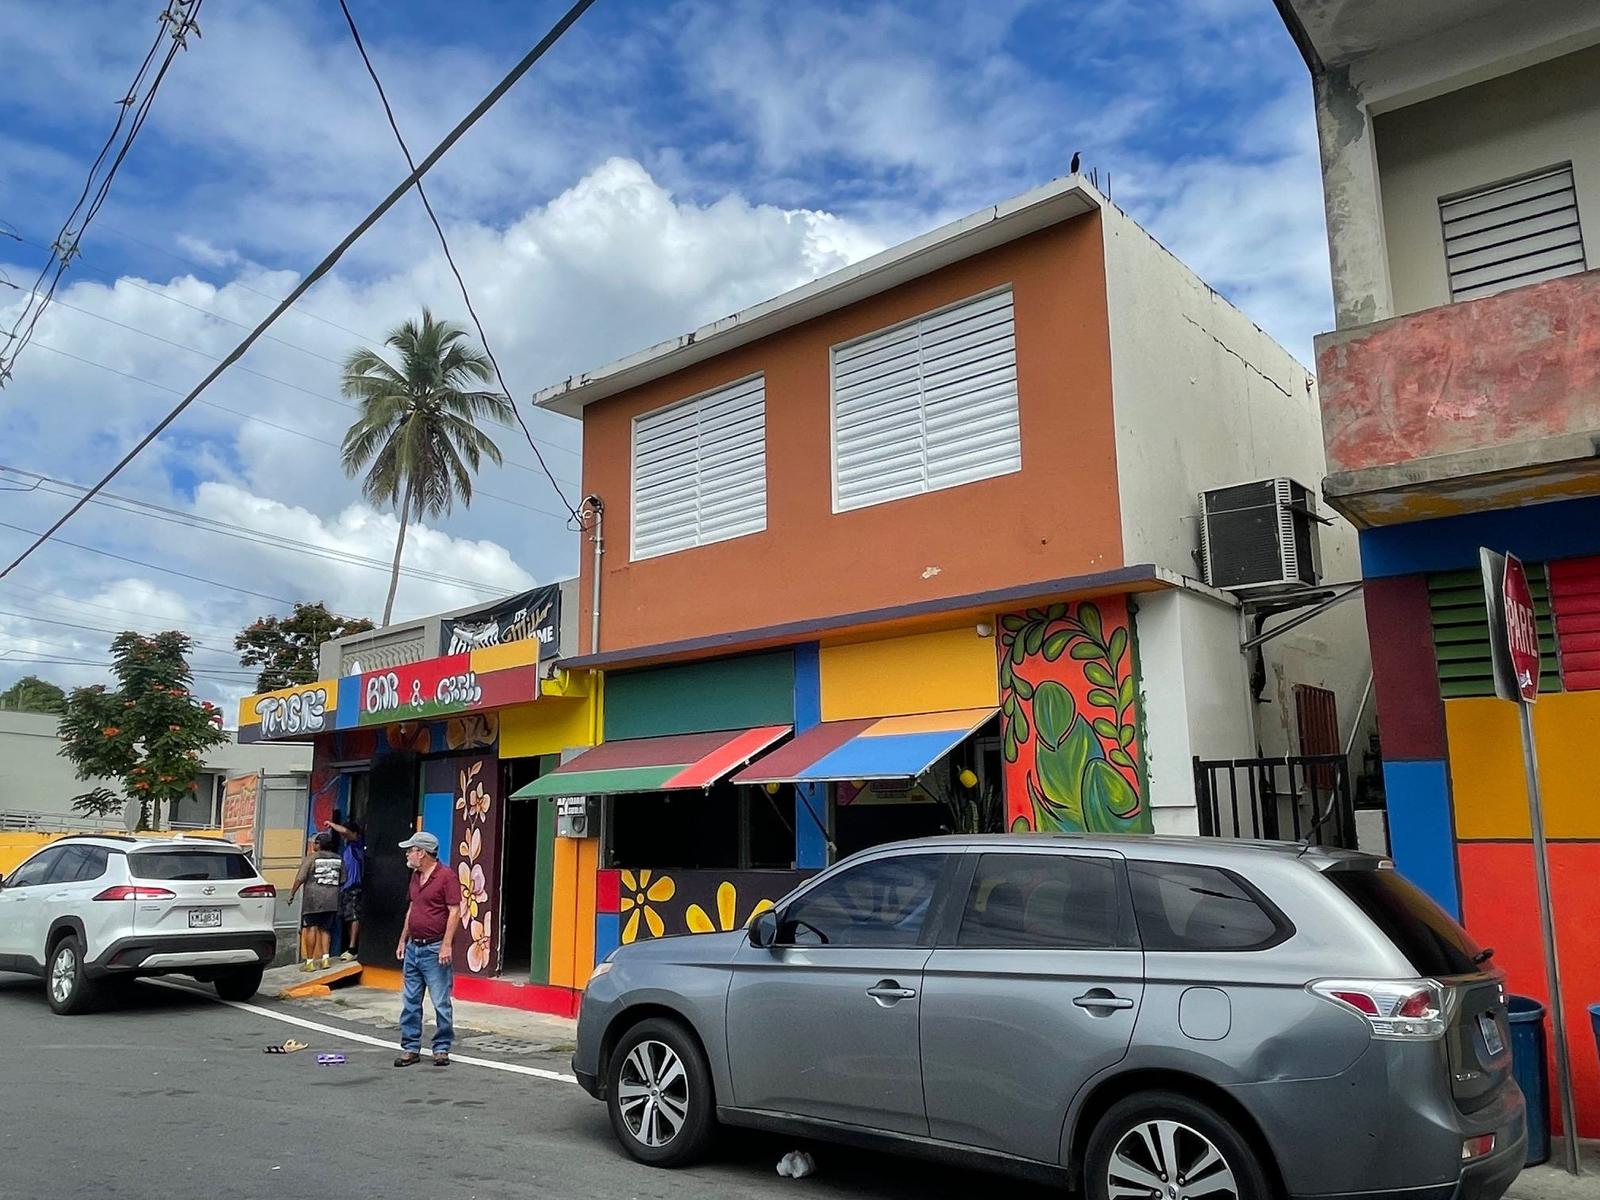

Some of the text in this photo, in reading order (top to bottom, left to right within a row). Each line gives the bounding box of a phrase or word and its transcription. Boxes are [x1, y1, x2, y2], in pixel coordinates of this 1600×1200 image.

[1507, 597, 1537, 658] PARE
[365, 671, 400, 714] BAR
[411, 679, 425, 707] &
